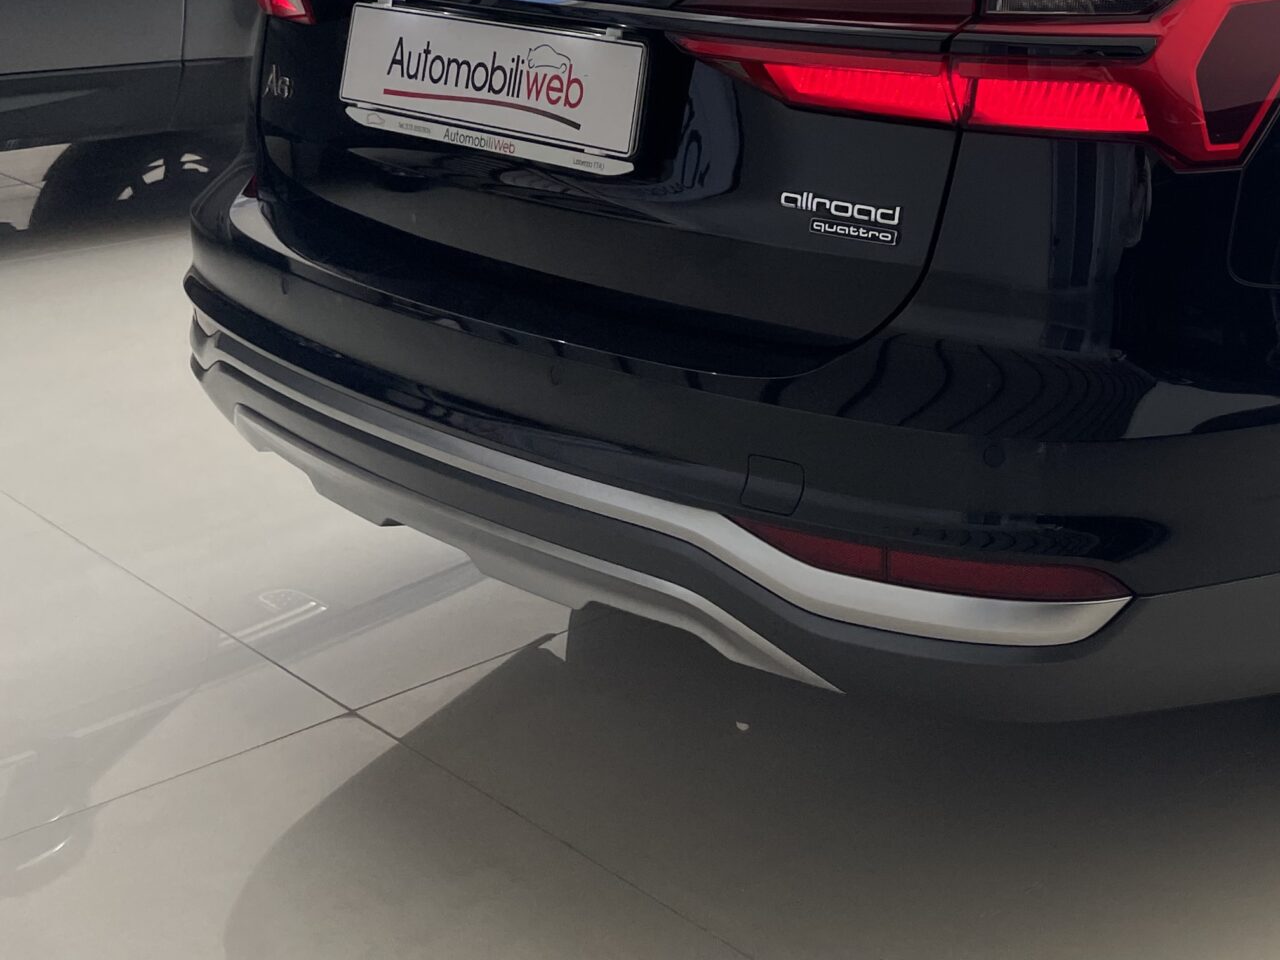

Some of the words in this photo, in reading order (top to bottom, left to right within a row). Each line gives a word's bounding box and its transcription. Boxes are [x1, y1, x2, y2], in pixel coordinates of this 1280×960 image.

[262, 64, 294, 98] A6
[387, 36, 584, 109] Automobiliweb
[443, 127, 515, 154] AutomobiliWeb
[780, 191, 901, 226] allroad
[812, 220, 892, 241] quattro
